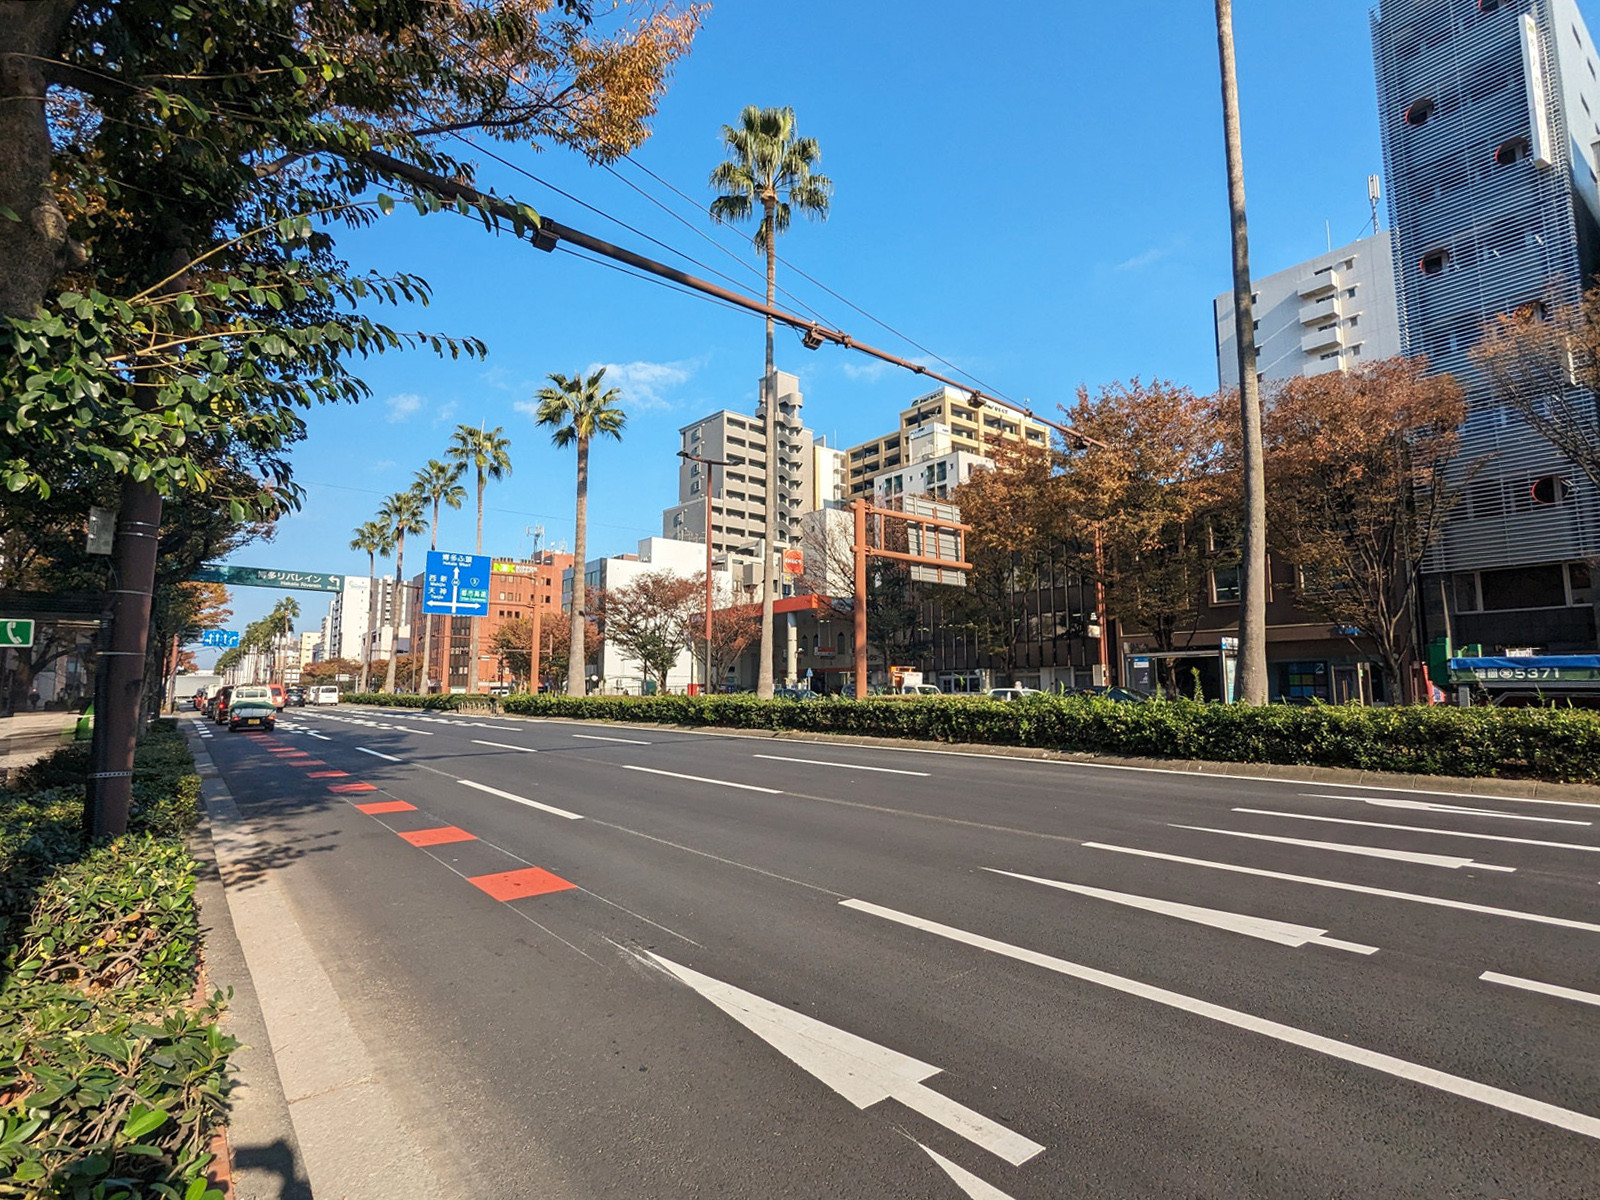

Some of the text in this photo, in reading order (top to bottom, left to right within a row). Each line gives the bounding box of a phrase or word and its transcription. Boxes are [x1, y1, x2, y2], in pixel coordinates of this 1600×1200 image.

[257, 570, 322, 583] 博多リバレイン
